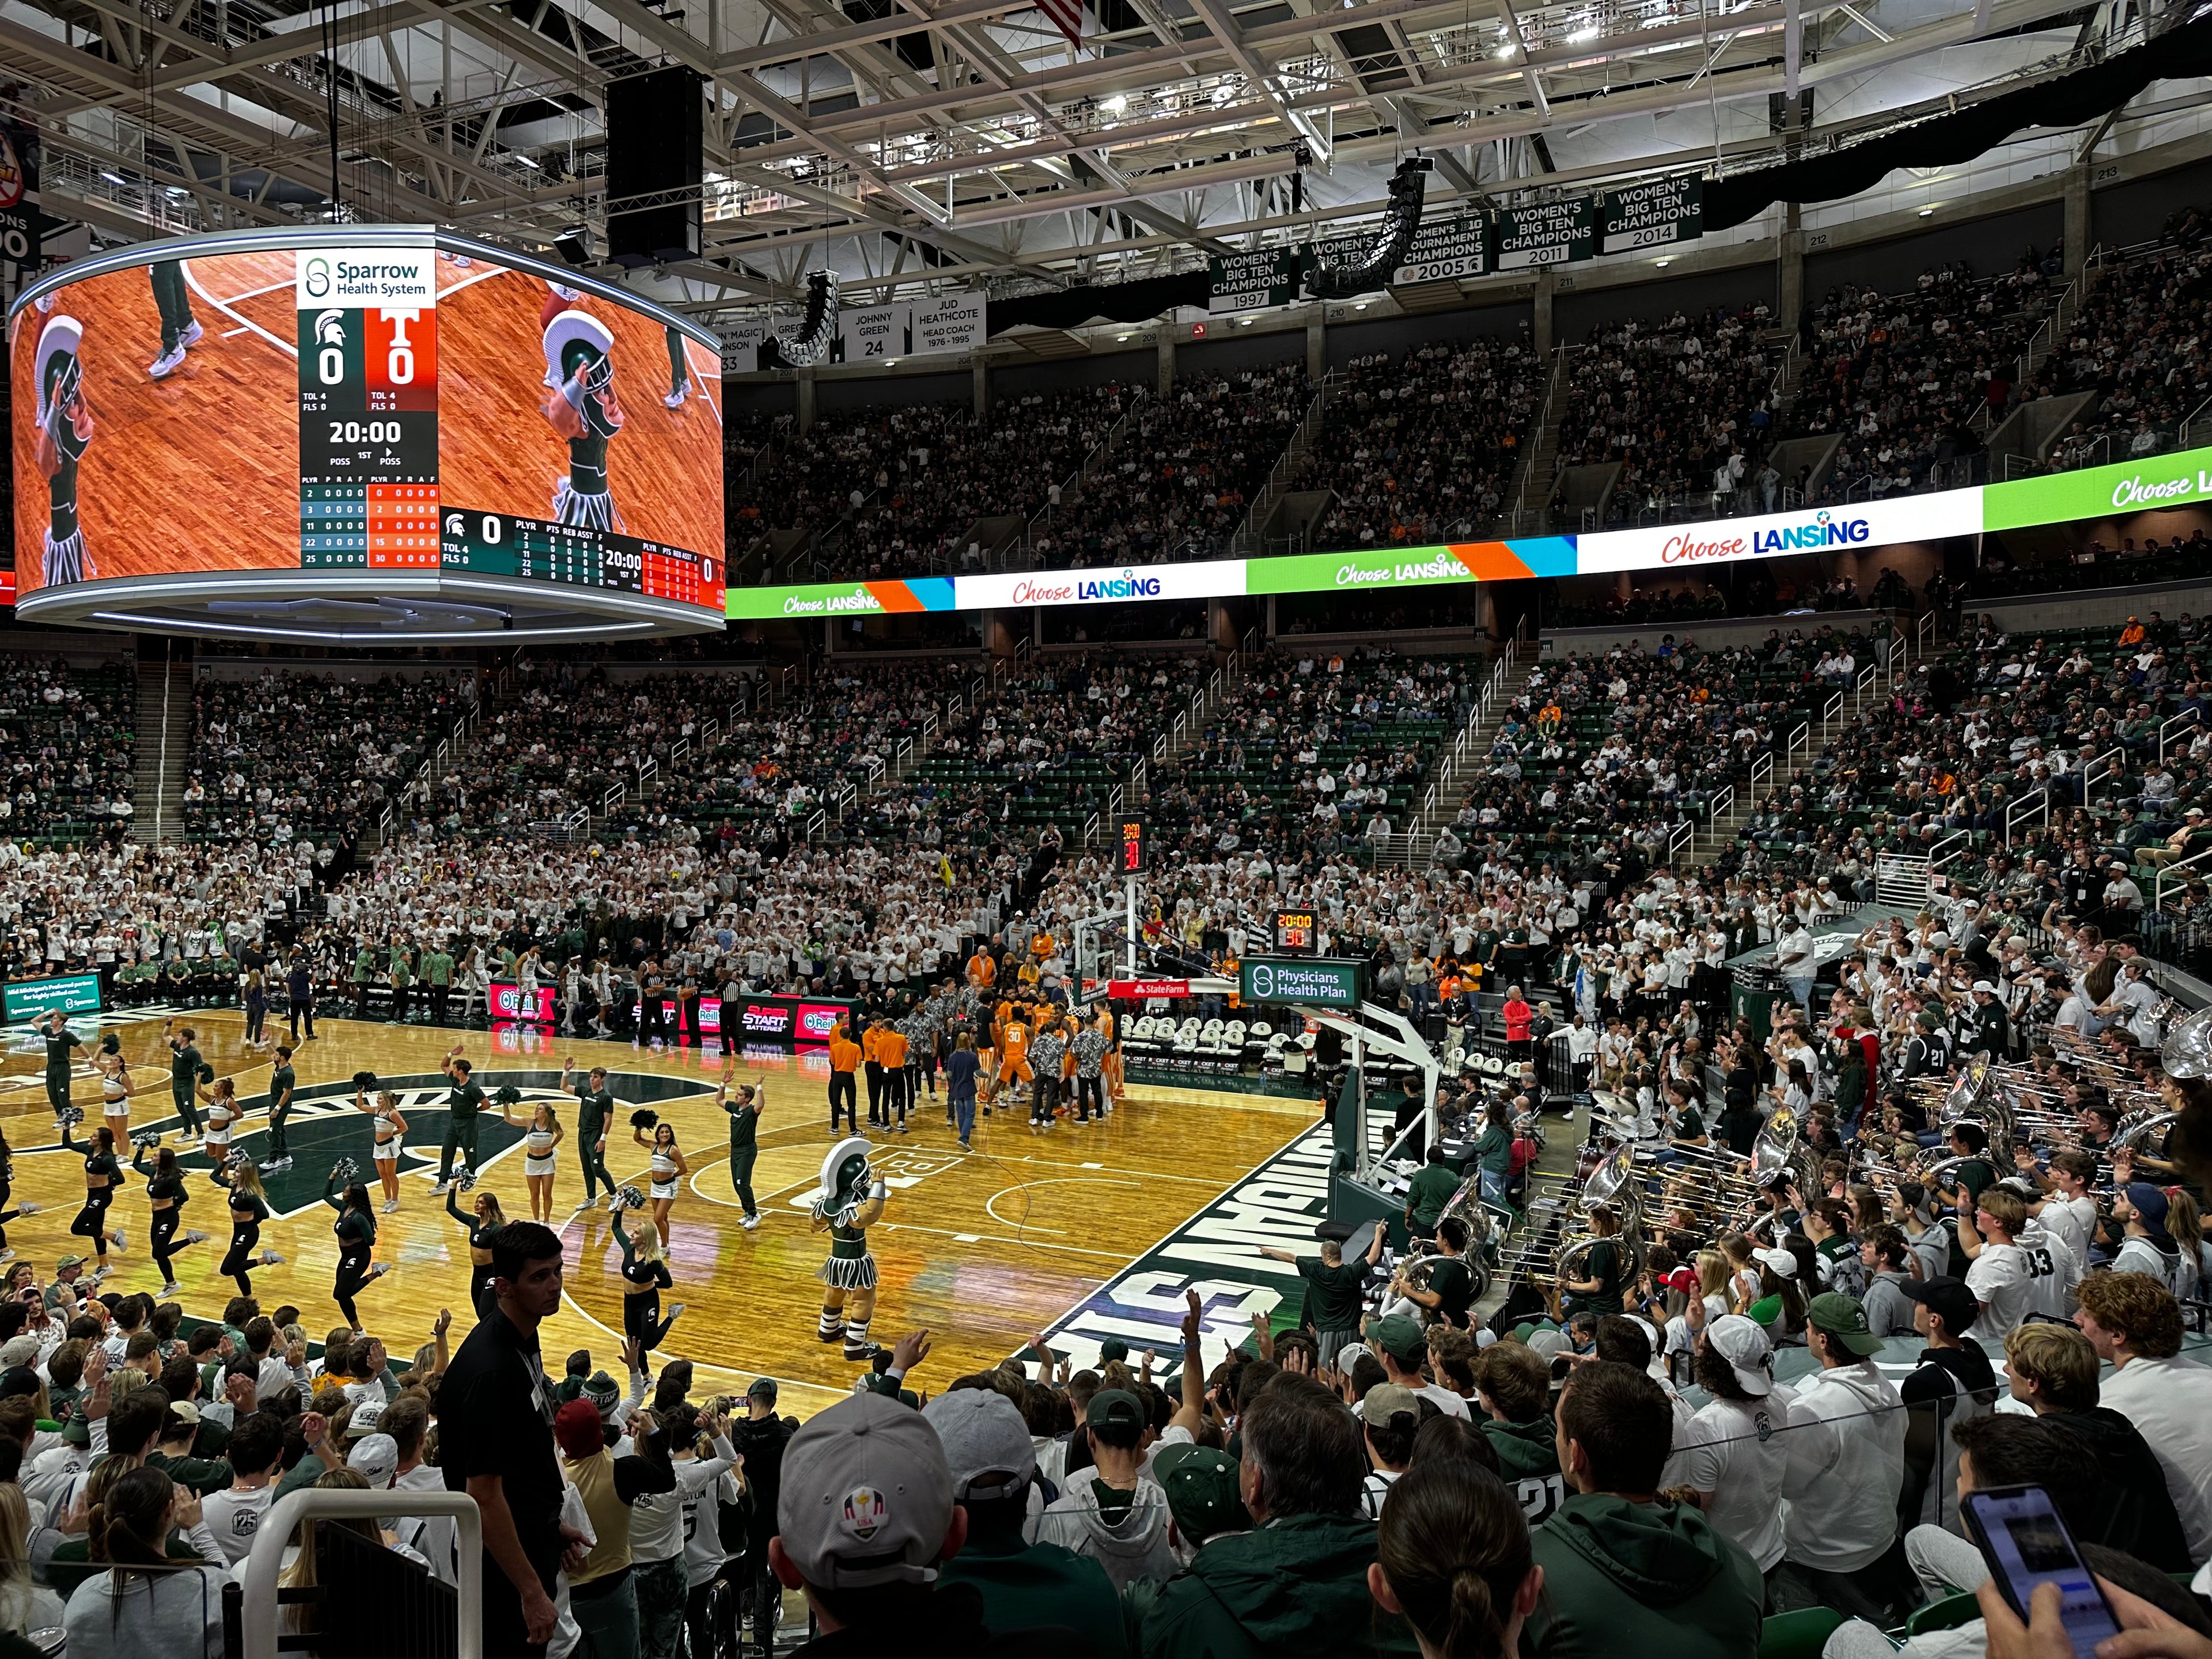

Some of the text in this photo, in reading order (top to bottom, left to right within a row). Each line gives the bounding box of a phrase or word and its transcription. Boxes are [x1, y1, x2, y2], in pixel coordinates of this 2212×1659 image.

[2098, 166, 2118, 181] 213
[1618, 178, 1690, 204] WOMEN'S
[1512, 202, 1581, 223] WOMEN'S
[1625, 194, 1682, 217] BIG TEN
[1519, 216, 1574, 235] BIG TEN
[1607, 203, 1700, 232] CHAMPIONS
[1415, 224, 1456, 238] OMEN'S
[1502, 226, 1592, 250] CHAMPIONS
[1633, 226, 1672, 245] 2014
[1411, 230, 1482, 250] OURNAMENT
[1810, 234, 1827, 246] 212
[1221, 251, 1280, 269] WOMEN'S
[1403, 241, 1483, 264] CHAMPIONS
[1529, 248, 1562, 264] 2011
[337, 262, 418, 283] Sparrow
[1226, 264, 1274, 281] BIG TEN
[1418, 260, 1464, 280] 2005
[338, 283, 426, 297] Health System
[1212, 273, 1288, 294] CHAMPIONS
[1560, 277, 1573, 287] 211
[939, 300, 958, 310] JUD
[1233, 293, 1264, 308] 1997
[855, 312, 892, 325] JOHNNY
[919, 309, 978, 325] HEATHCOTE
[1331, 308, 1344, 317] 210
[380, 308, 420, 347] T
[859, 324, 889, 336] GREEN
[923, 324, 975, 337] HEAD COACH
[721, 342, 749, 351] HNSON
[865, 340, 884, 356] 24
[928, 335, 969, 347] 1976 1995
[319, 347, 414, 385] 0 0
[722, 357, 737, 370] 33
[957, 356, 971, 365] 208
[329, 421, 401, 443] 20:00
[307, 490, 312, 498] 2
[2112, 475, 2194, 507] Choose
[308, 506, 313, 514] 3
[482, 516, 501, 544] 0
[516, 520, 536, 531] PLYR
[546, 525, 559, 534] PTS
[563, 528, 576, 536] REB
[577, 531, 593, 539] ASST
[442, 543, 469, 554] TOL 4
[643, 543, 657, 552] PLYR
[662, 547, 672, 556] PTS
[673, 550, 681, 558] REB
[682, 551, 692, 560] ASST
[1662, 532, 1747, 563] Choose
[306, 555, 316, 563] 25
[443, 554, 469, 564] FLS 0
[522, 559, 531, 567] 22
[606, 550, 642, 570] 20:00
[704, 558, 712, 582] 0
[1336, 564, 1392, 585] Choose
[1013, 582, 1074, 604] Choose
[783, 596, 825, 613] Choose
[1278, 914, 1312, 928] 20:00
[1285, 929, 1305, 946] 30
[1277, 969, 1339, 986] Physicians
[1278, 983, 1346, 998] Health Plan
[747, 1005, 788, 1017] SUPER
[741, 1013, 789, 1026] START
[746, 1024, 783, 1032] BATTERIES
[1007, 1031, 1021, 1043] 30
[1931, 1049, 1944, 1066] 21
[1517, 1474, 1565, 1520] 21
[232, 1513, 257, 1528] 125
[857, 1518, 874, 1527] USA
